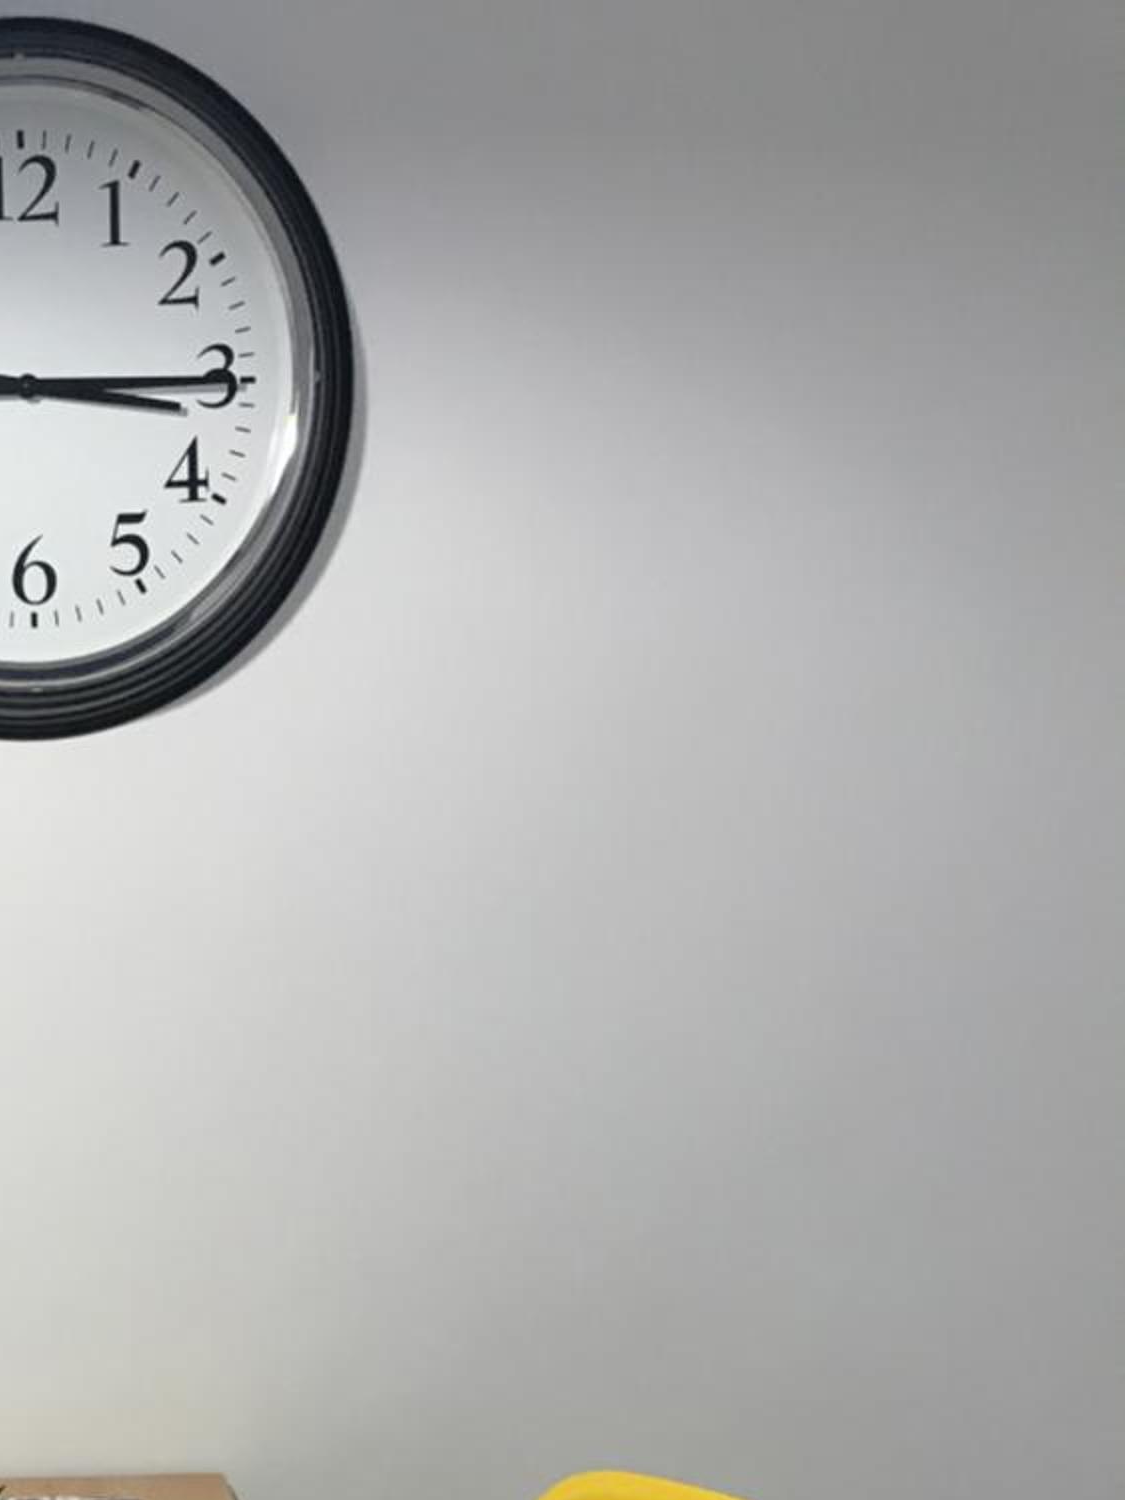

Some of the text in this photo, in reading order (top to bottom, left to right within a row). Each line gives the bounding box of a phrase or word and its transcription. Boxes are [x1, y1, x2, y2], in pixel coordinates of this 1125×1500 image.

[99, 180, 133, 246] 1
[158, 240, 203, 307] 2
[196, 344, 237, 408] 3
[165, 437, 209, 502] 4
[12, 537, 57, 605] 6
[111, 512, 149, 576] 5
